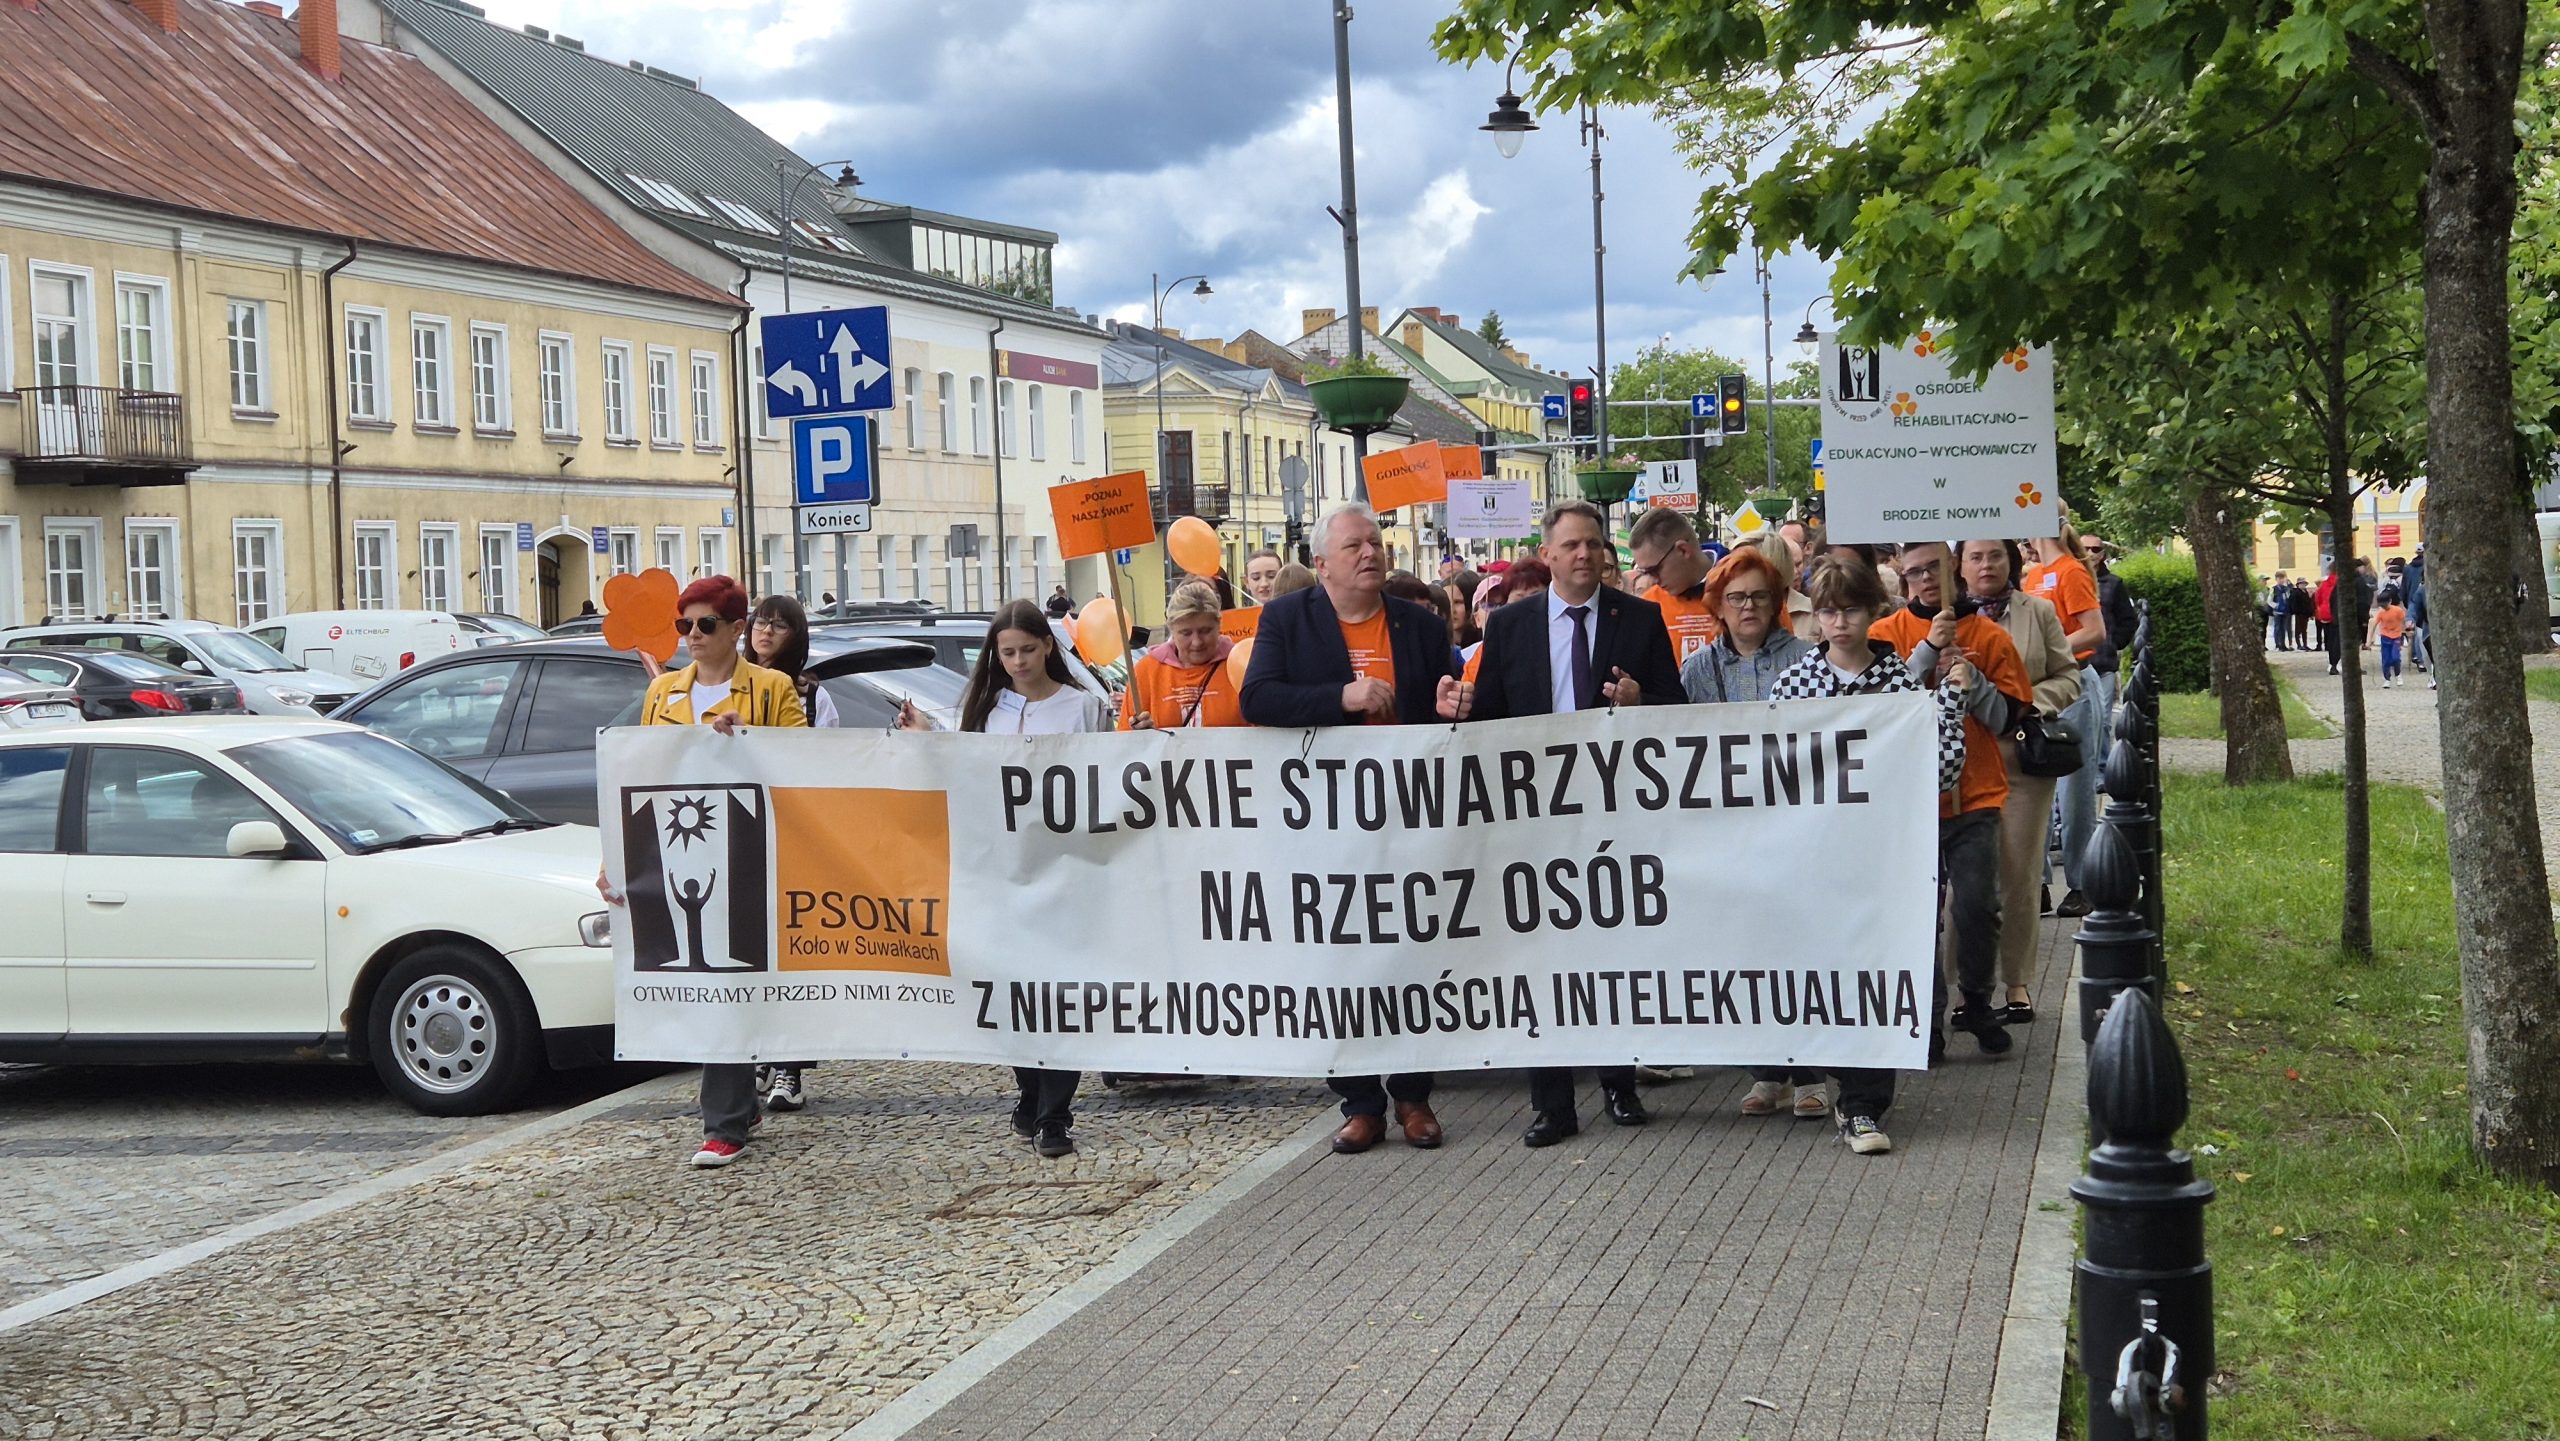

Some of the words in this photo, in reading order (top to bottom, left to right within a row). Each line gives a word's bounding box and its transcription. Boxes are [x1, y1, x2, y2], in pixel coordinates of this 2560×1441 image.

[1915, 381, 1982, 396] OŚRODEK
[809, 426, 853, 494] P
[1376, 457, 1431, 481] GODNOŚĆ
[1444, 469, 1473, 479] TACJA
[1933, 477, 1947, 489] W
[1656, 494, 1692, 506] PSONI
[807, 510, 862, 528] Koniec
[1071, 510, 1100, 523] NASZ
[1882, 508, 1941, 521] BRODZIE
[1946, 506, 2001, 520] NOWYM
[1001, 759, 1258, 834] POLSKIE
[1281, 729, 1869, 831] STOWARZYSZENIE
[1200, 871, 1272, 942] NA
[1291, 868, 1481, 945] RZECZ
[1502, 840, 1668, 934] OSÓB
[785, 890, 941, 938] PSONI
[790, 936, 830, 956] Koło
[835, 940, 850, 955] w
[855, 936, 940, 961] Suwałkach
[633, 985, 756, 1004] OTWIERAMY
[763, 984, 837, 1002] PRZED
[844, 984, 891, 1001] NIMI
[897, 983, 956, 1006] ŻYCIE
[972, 980, 998, 1031] Z
[1010, 970, 1540, 1040] NIEPEŁNOSPRAWNOŚCIĄ
[1552, 969, 1920, 1039] INTELEKTUALNĄ
